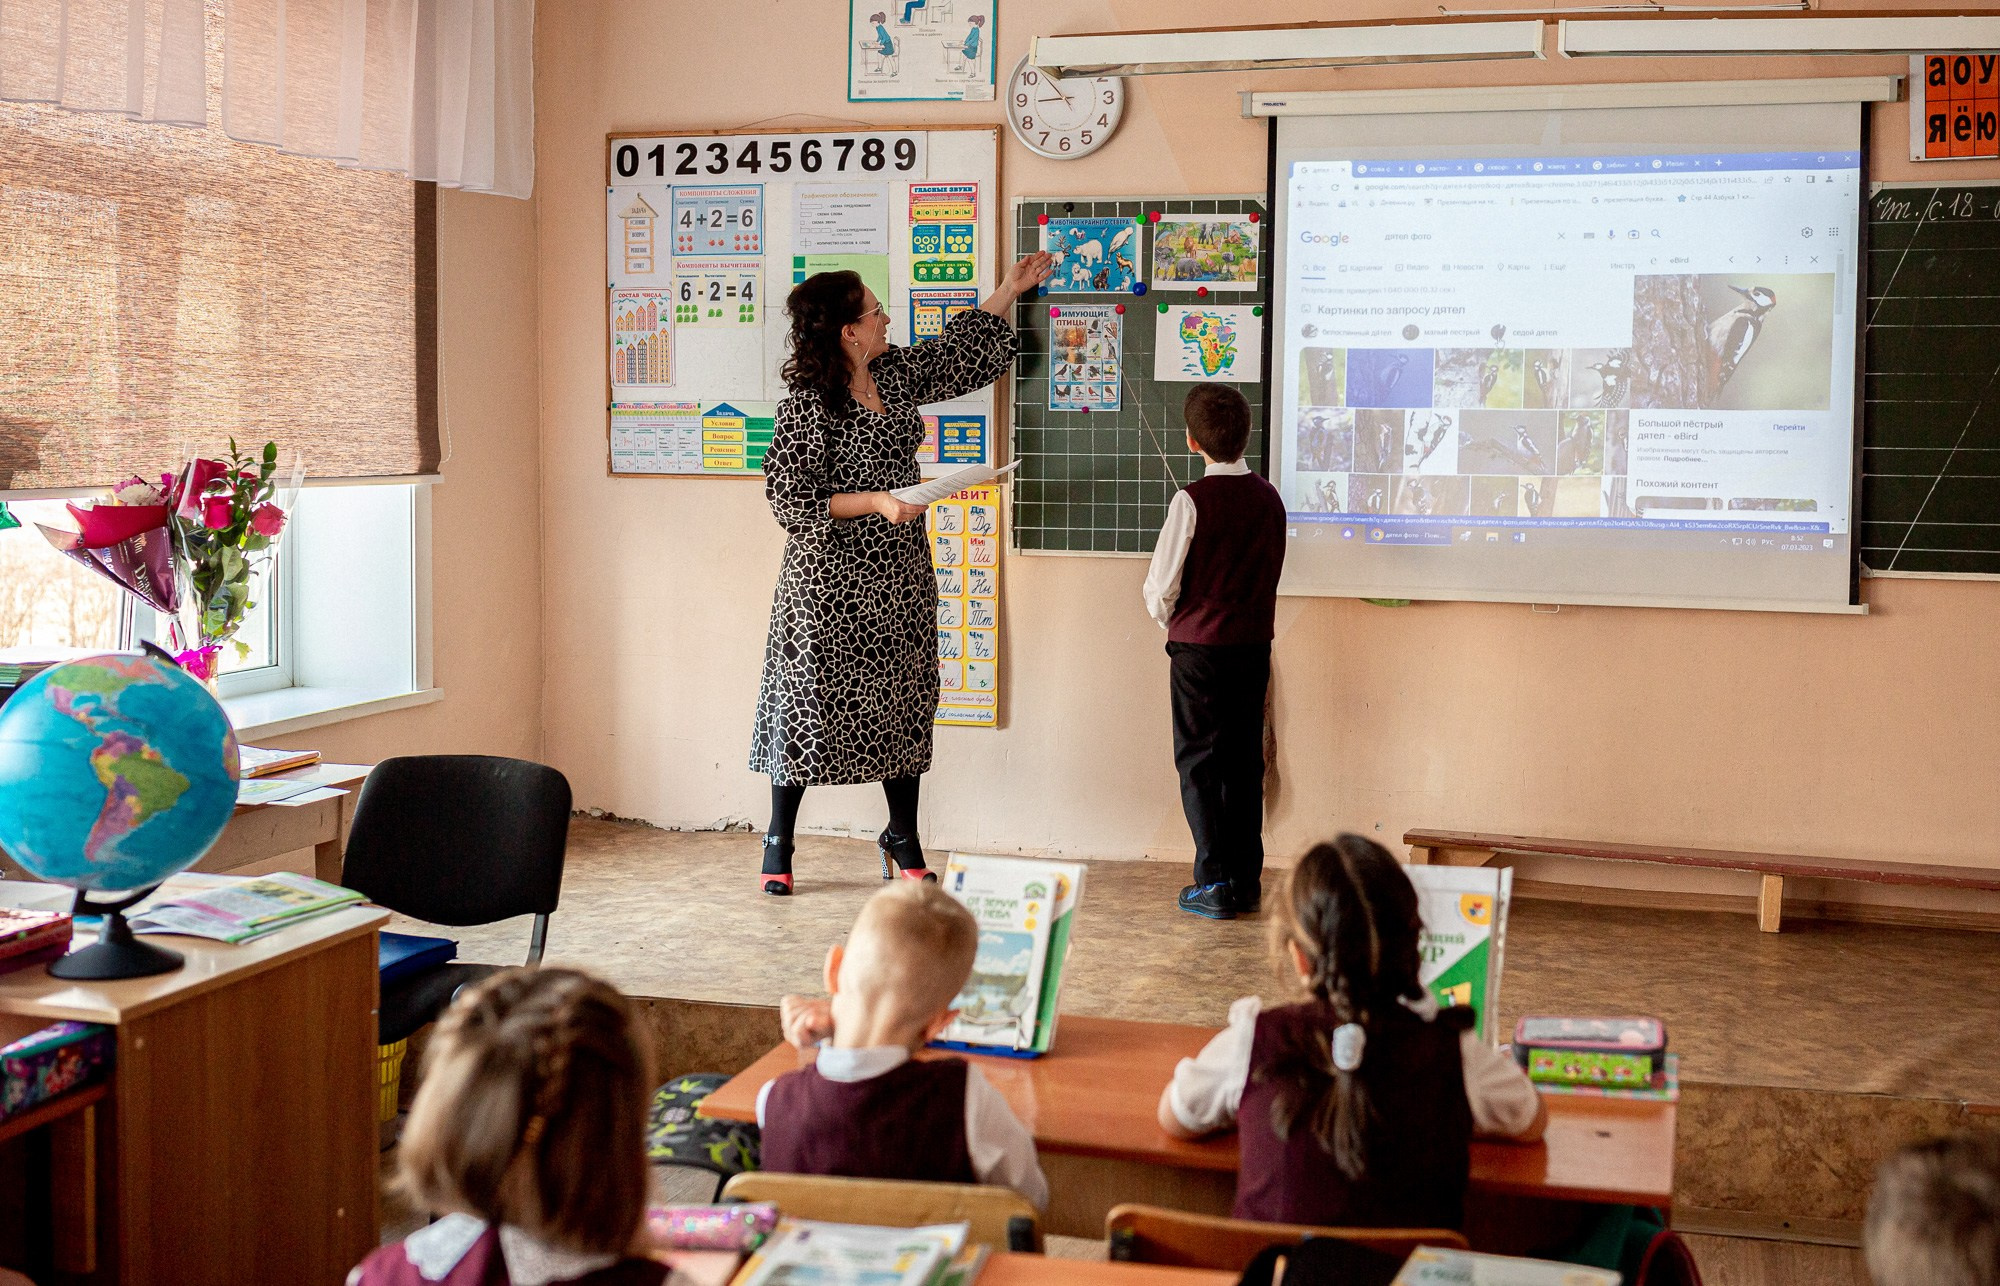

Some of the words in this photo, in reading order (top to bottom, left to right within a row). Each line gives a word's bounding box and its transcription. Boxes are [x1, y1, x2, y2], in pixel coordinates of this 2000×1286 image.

[1021, 71, 1038, 86] 10
[1016, 94, 1027, 107] 9
[1103, 90, 1114, 104] 3
[1022, 116, 1034, 130] 8
[1097, 113, 1108, 128] 4
[1954, 106, 1971, 141] ё
[1039, 132, 1050, 146] 7
[1059, 137, 1071, 151] 6
[1081, 130, 1092, 145] 5
[680, 210, 692, 228] 4
[710, 209, 722, 228] 2
[742, 208, 753, 227] 6
[1300, 231, 1349, 246] Google
[1411, 232, 1432, 242] фото
[1350, 264, 1383, 272] Картинки
[1406, 264, 1429, 272] Видео
[681, 282, 691, 301] 6
[710, 282, 720, 301] 2
[741, 282, 753, 301] 4
[1318, 305, 1367, 316] Картинки
[1371, 307, 1383, 315] по
[1387, 306, 1430, 316] запросу
[1432, 306, 1466, 315] дятел
[1638, 419, 1681, 428] Большой
[1683, 420, 1723, 430] пёстрый
[1674, 432, 1698, 440] eBird
[1636, 480, 1678, 488] Похожий
[1681, 481, 1718, 489] контент
[945, 491, 989, 500] АВИТ
[970, 506, 985, 515] Дд
[970, 538, 985, 546] Ии
[936, 568, 953, 576] Мм
[970, 569, 985, 577] Нн
